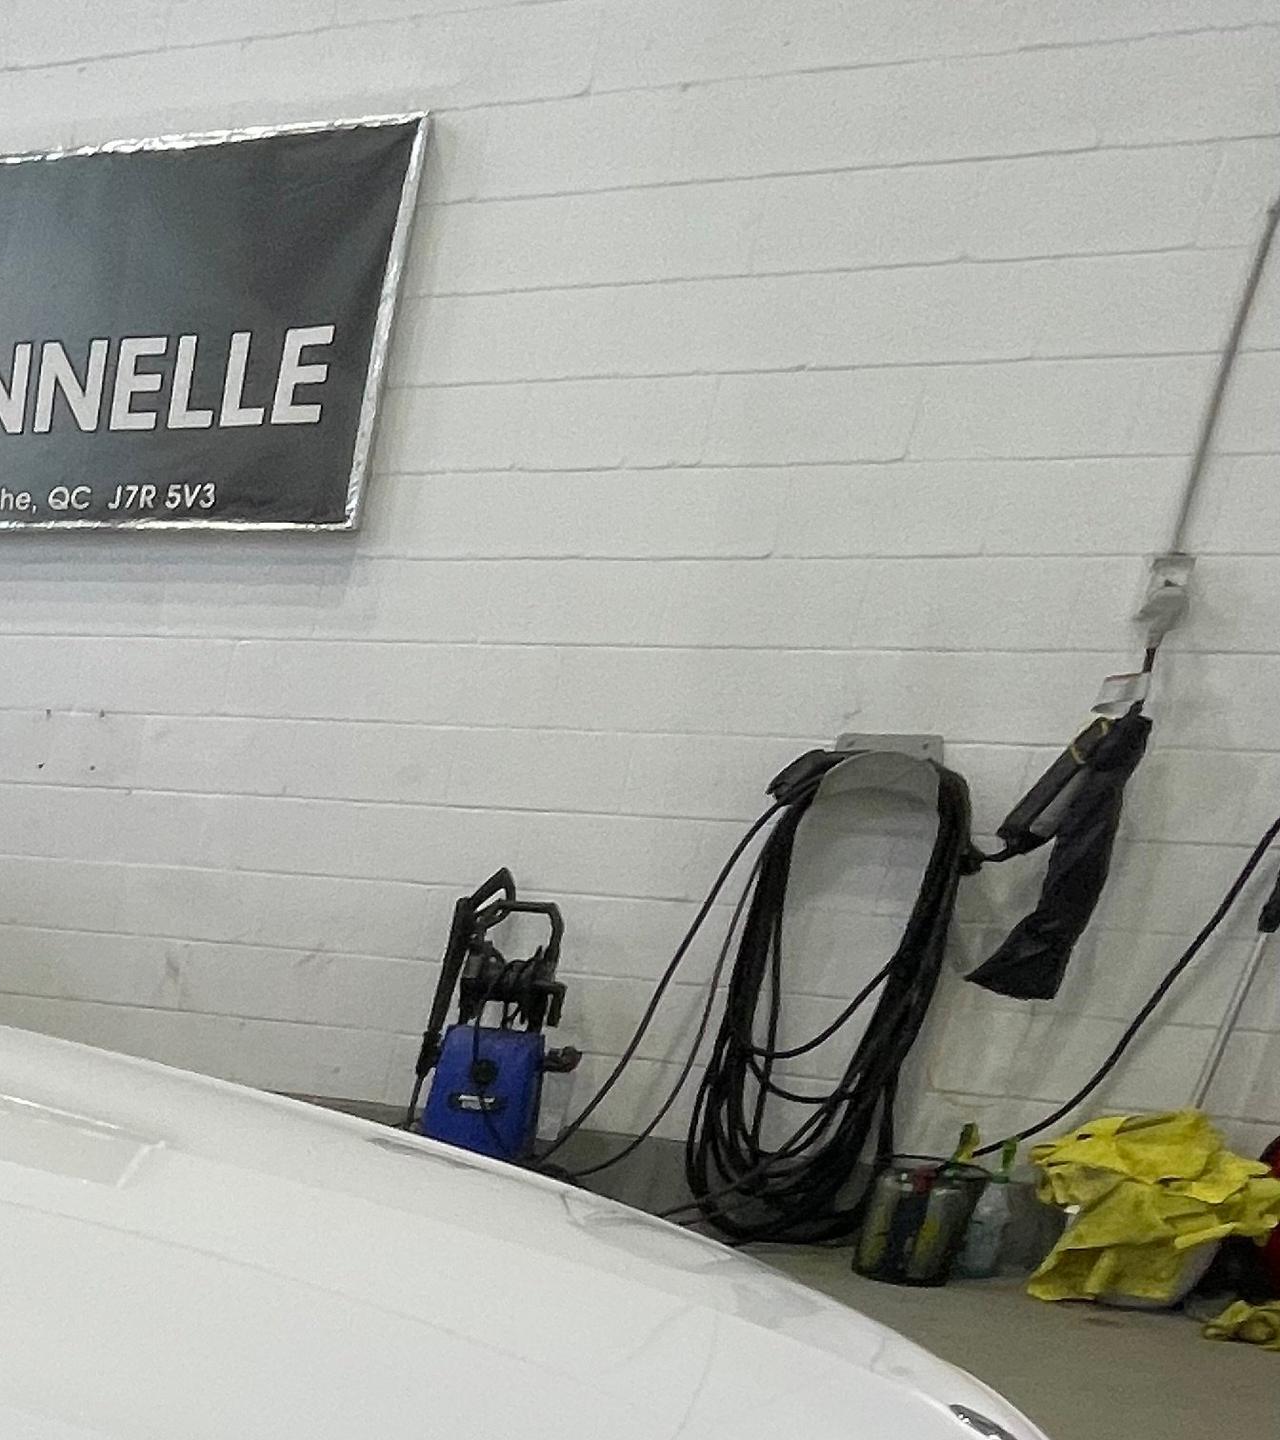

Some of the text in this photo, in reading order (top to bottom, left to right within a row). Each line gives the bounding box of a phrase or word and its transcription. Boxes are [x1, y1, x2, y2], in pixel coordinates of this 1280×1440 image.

[47, 485, 92, 512] QC
[107, 483, 157, 511] J7R
[164, 482, 217, 510] 5V3
